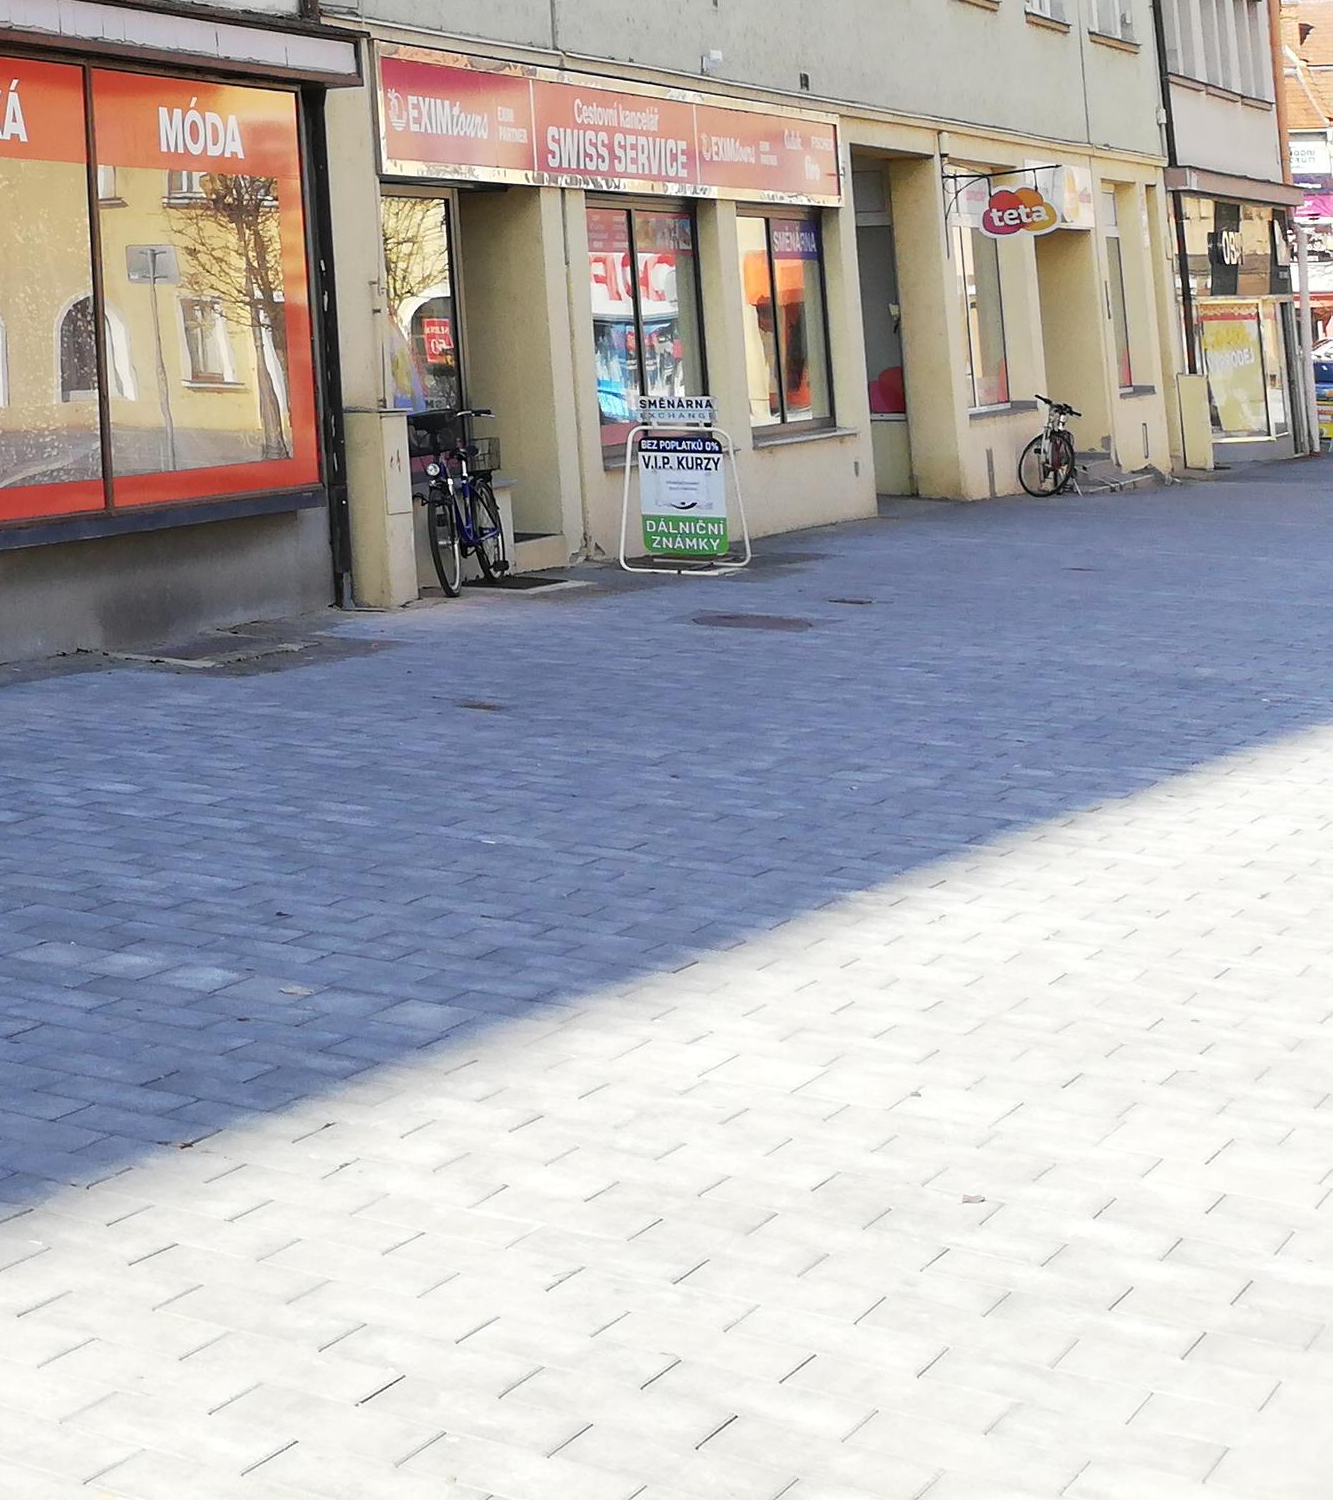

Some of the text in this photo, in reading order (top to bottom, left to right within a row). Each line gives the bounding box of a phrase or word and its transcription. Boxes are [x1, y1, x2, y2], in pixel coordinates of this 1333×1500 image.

[574, 98, 659, 132] Cestovní kancelář
[157, 98, 245, 159] MÓDA
[547, 126, 688, 178] SWISS SERVICE
[990, 204, 1049, 228] teta
[773, 226, 818, 253] SMĚNÁRNA
[639, 397, 713, 409] SMĚNÁRNA
[641, 439, 720, 452] BEZ POPLATKŮ 0%
[642, 455, 721, 471] V.I.P. KURZY
[646, 518, 725, 536] DÁLNIČNÍ
[651, 534, 721, 550] ZNÁMKY
